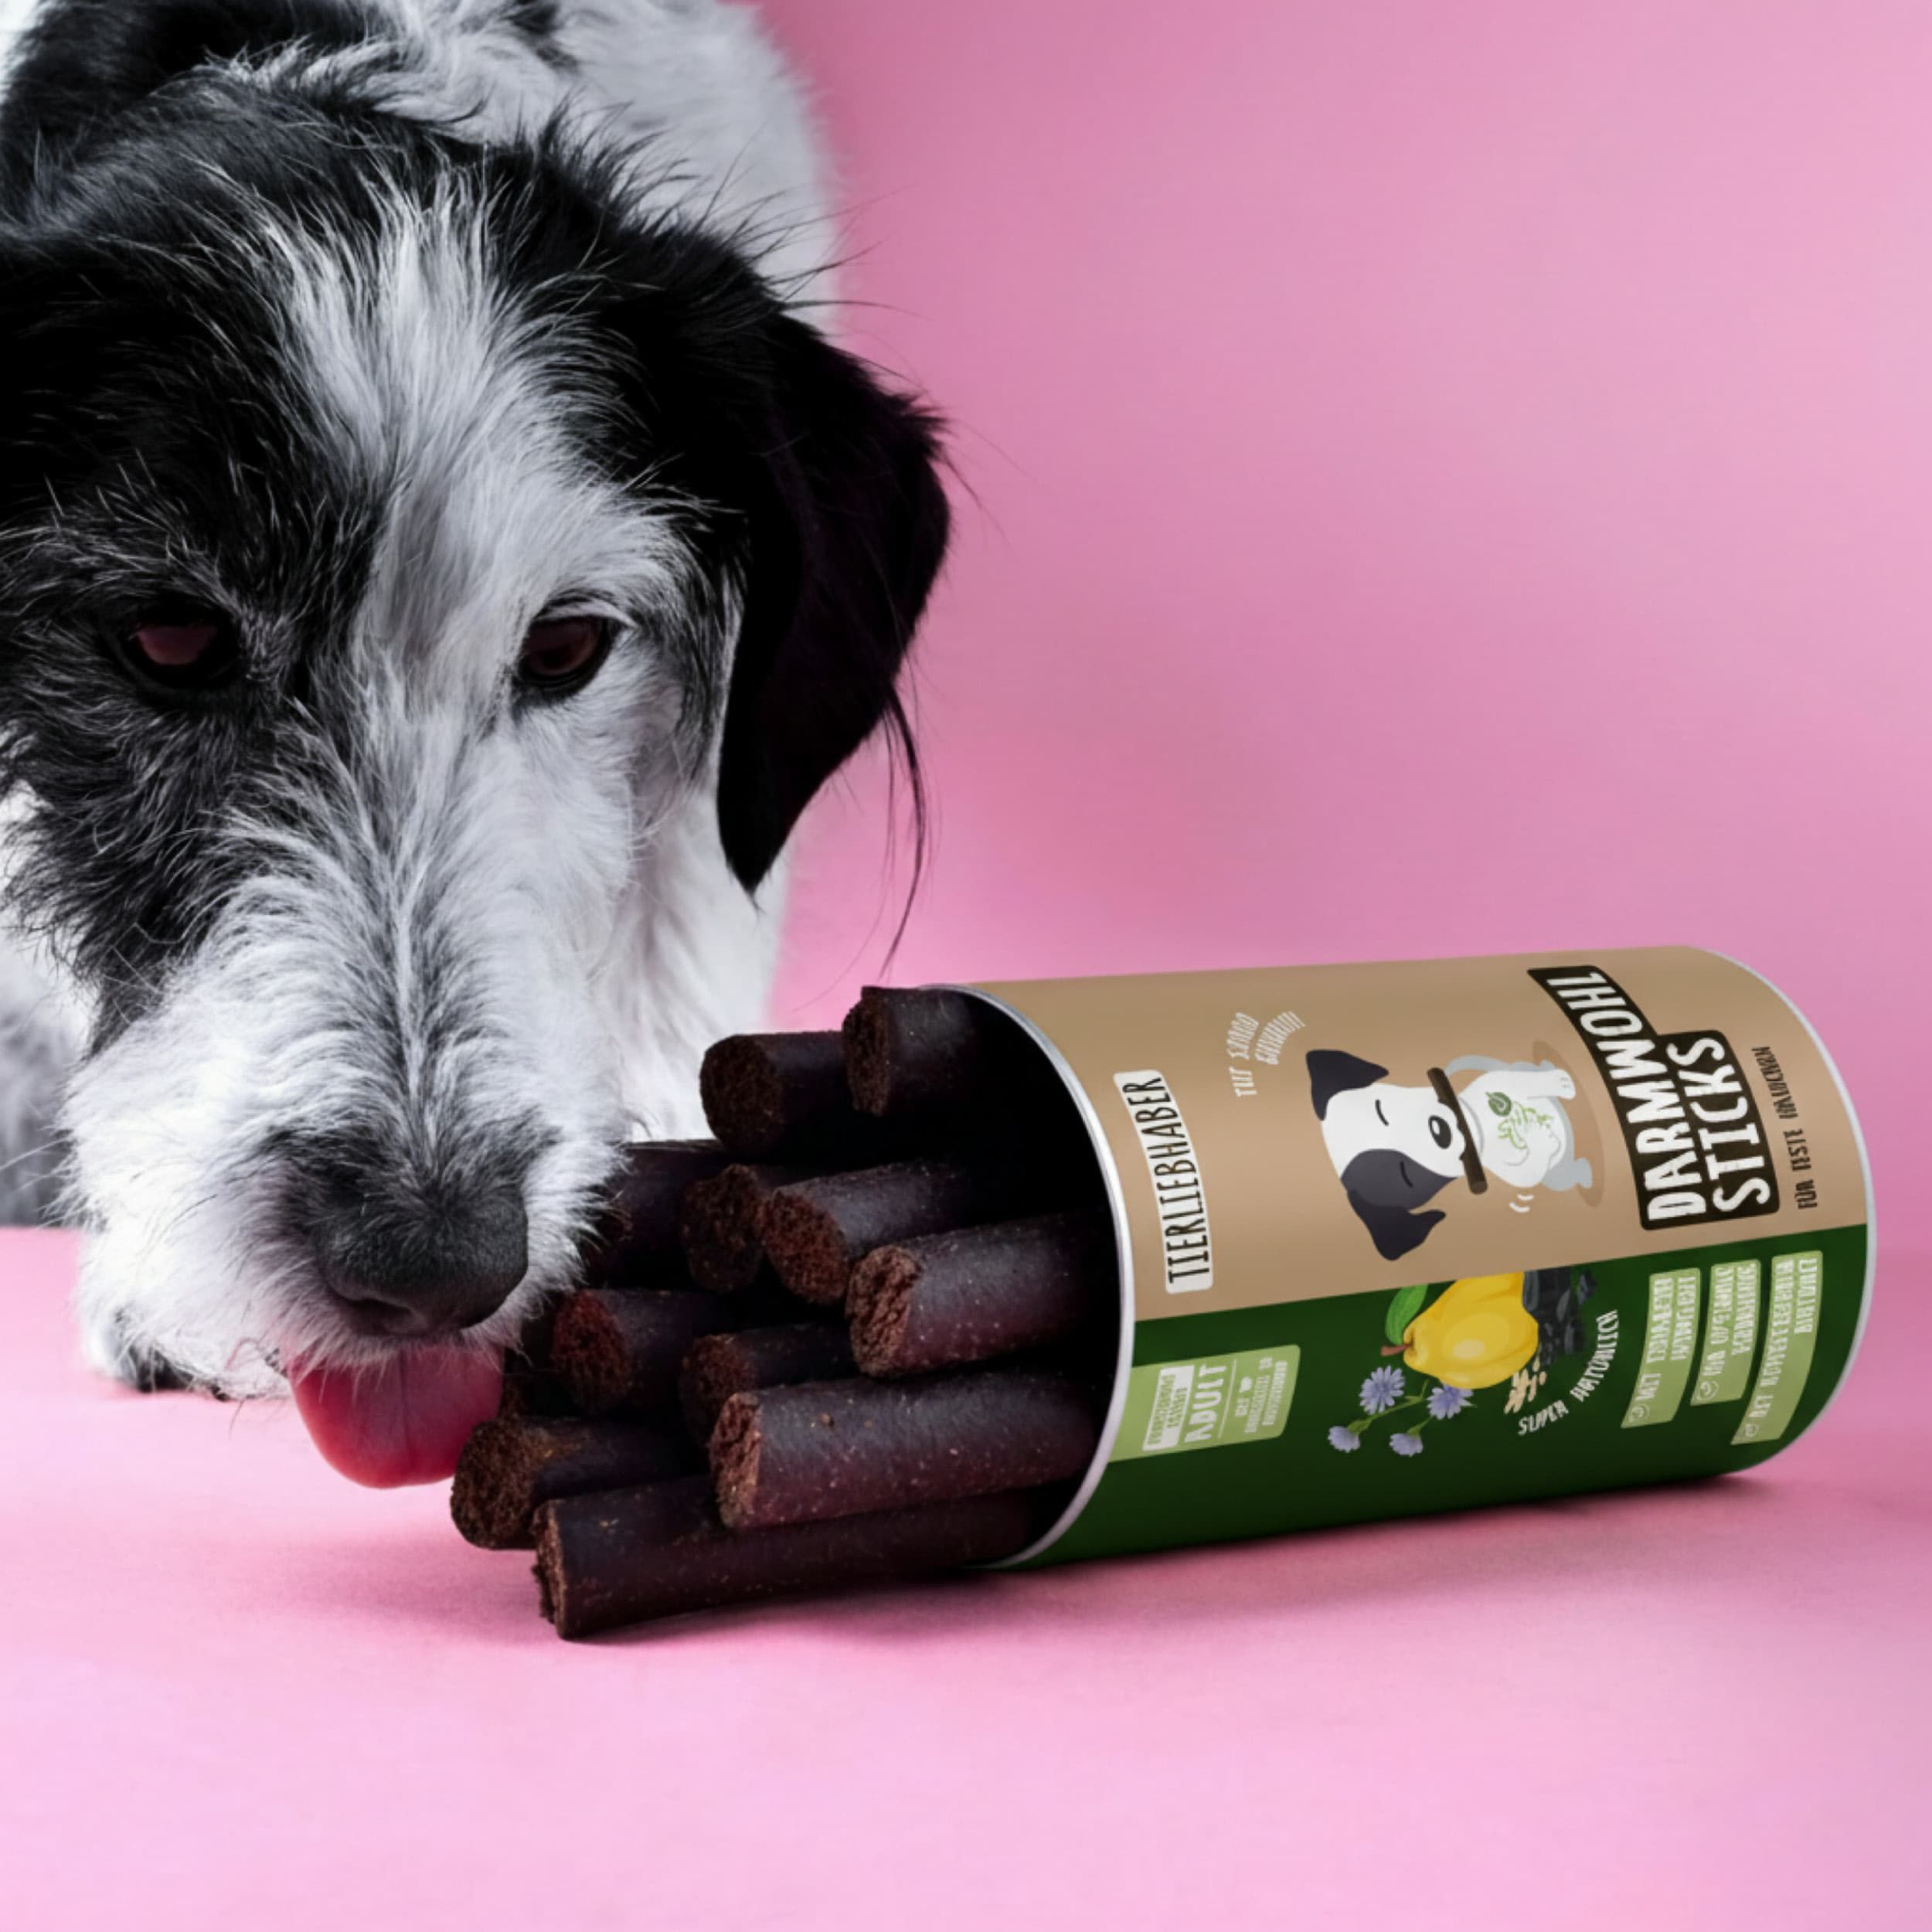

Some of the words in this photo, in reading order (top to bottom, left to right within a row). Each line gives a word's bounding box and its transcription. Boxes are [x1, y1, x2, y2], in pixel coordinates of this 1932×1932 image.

[1121, 1077, 1210, 1284] TIERLIEBHABER
[1546, 971, 1708, 1222] DARMWOHL
[1666, 1037, 1771, 1213] STICKS
[1183, 1363, 1227, 1444] ADULT
[1517, 1399, 1570, 1437] SUPER
